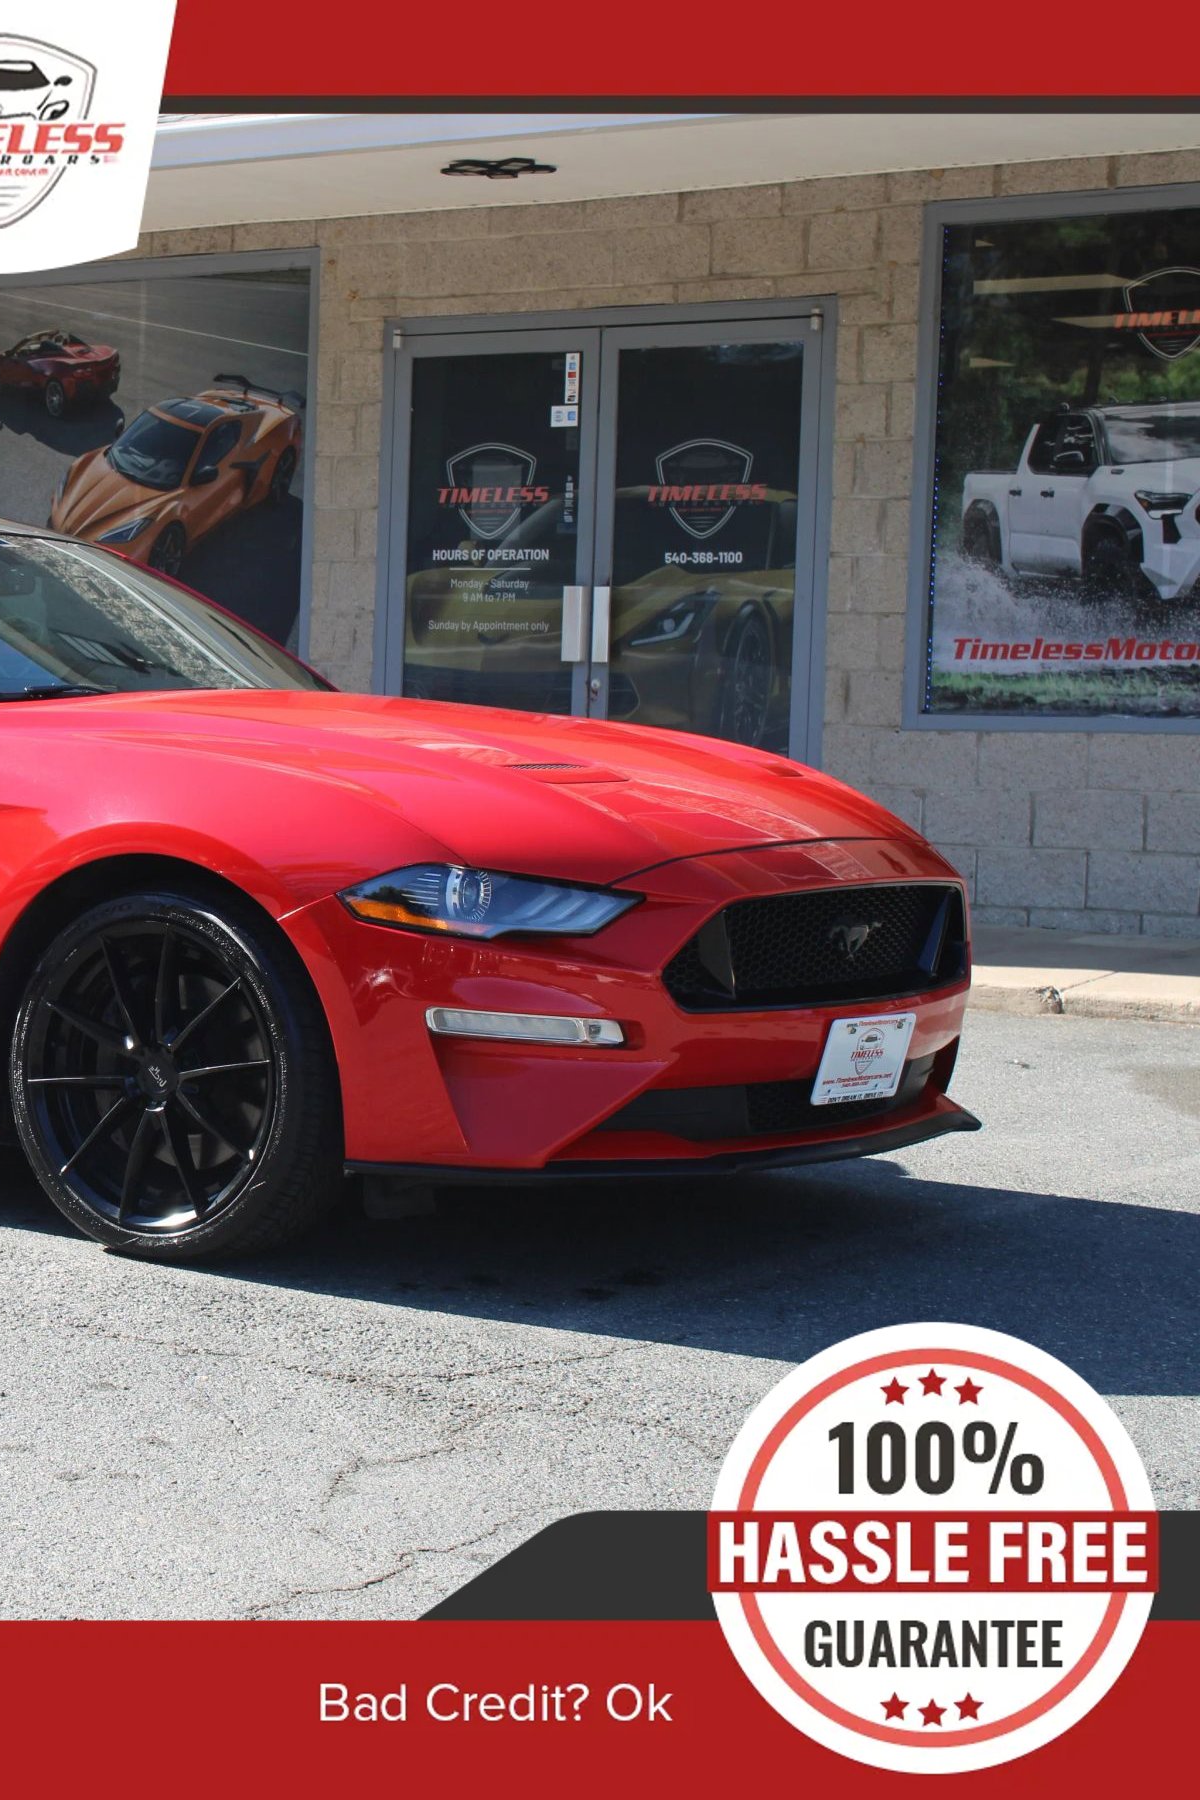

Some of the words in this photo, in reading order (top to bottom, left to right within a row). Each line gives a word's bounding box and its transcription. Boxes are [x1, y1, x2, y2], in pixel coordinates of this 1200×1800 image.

[437, 486, 550, 504] TIMELESS
[648, 484, 768, 503] TIMELESS
[432, 549, 469, 561] HOURS
[471, 549, 485, 560] OF
[487, 548, 549, 561] OPERATION
[664, 551, 743, 564] 540-368-1100
[450, 579, 483, 591] Monday
[490, 578, 530, 590] Saturday
[463, 593, 469, 602] 9
[470, 592, 483, 602] AM
[485, 593, 494, 602] to
[495, 592, 502, 602] 7
[503, 592, 516, 602] PM
[428, 619, 460, 632] Sunday
[461, 620, 471, 632] by
[472, 620, 529, 632] Appointment
[530, 620, 550, 632] only
[953, 637, 1200, 661] TimelessMoto
